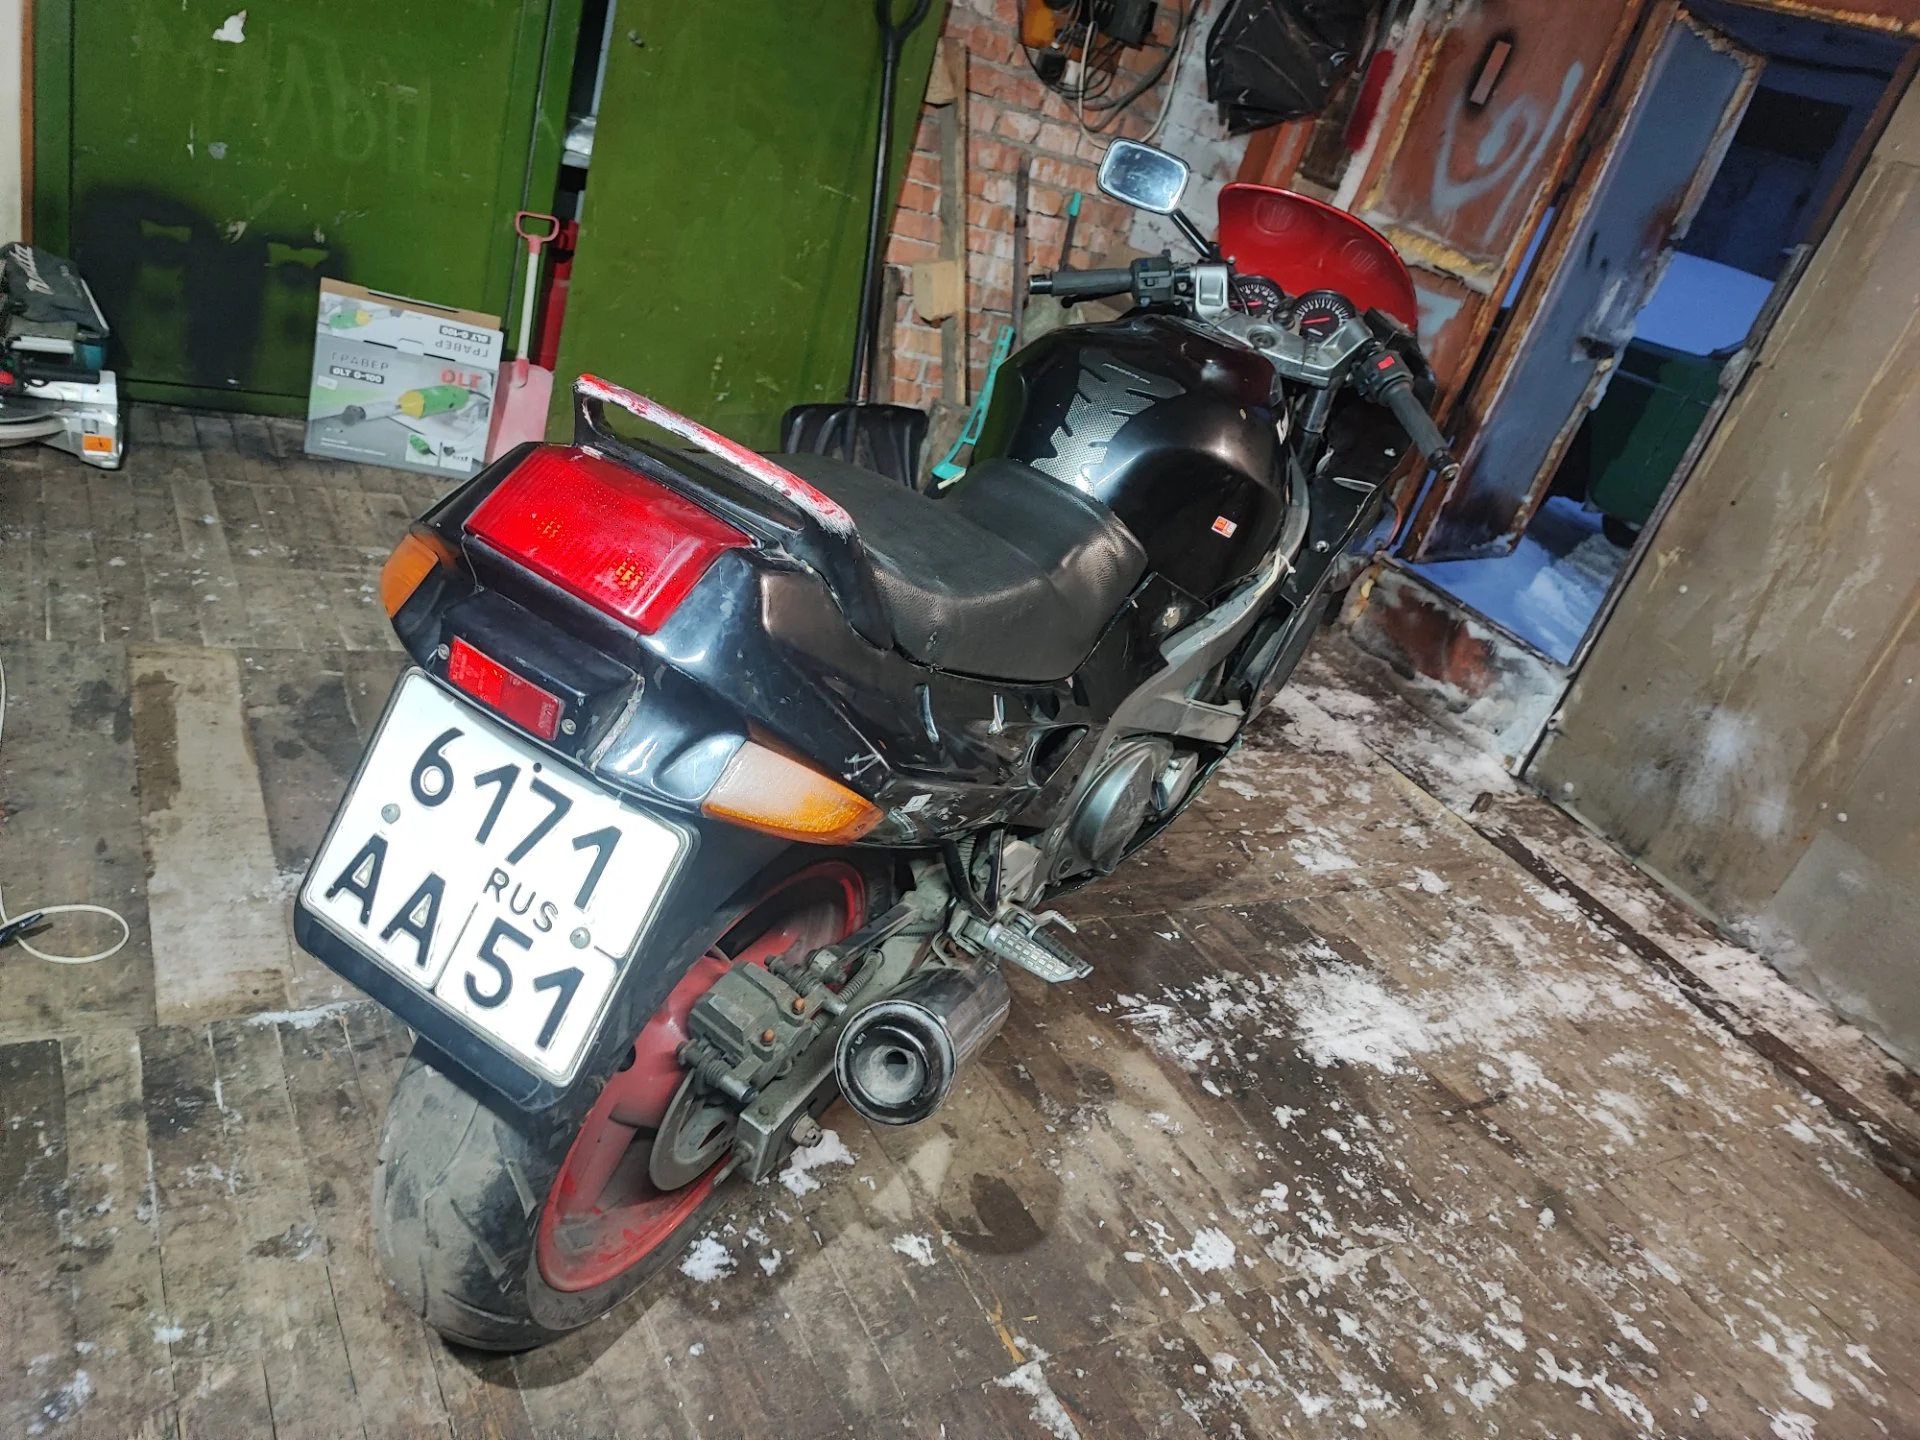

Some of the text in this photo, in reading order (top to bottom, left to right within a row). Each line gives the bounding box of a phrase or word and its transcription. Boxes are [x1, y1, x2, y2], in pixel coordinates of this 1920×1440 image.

[331, 351, 389, 371] ГРАВЕР
[435, 340, 489, 358] ГРАВЕР
[410, 727, 622, 910] 6171
[482, 867, 559, 932] RUS
[464, 917, 585, 1052] 51
